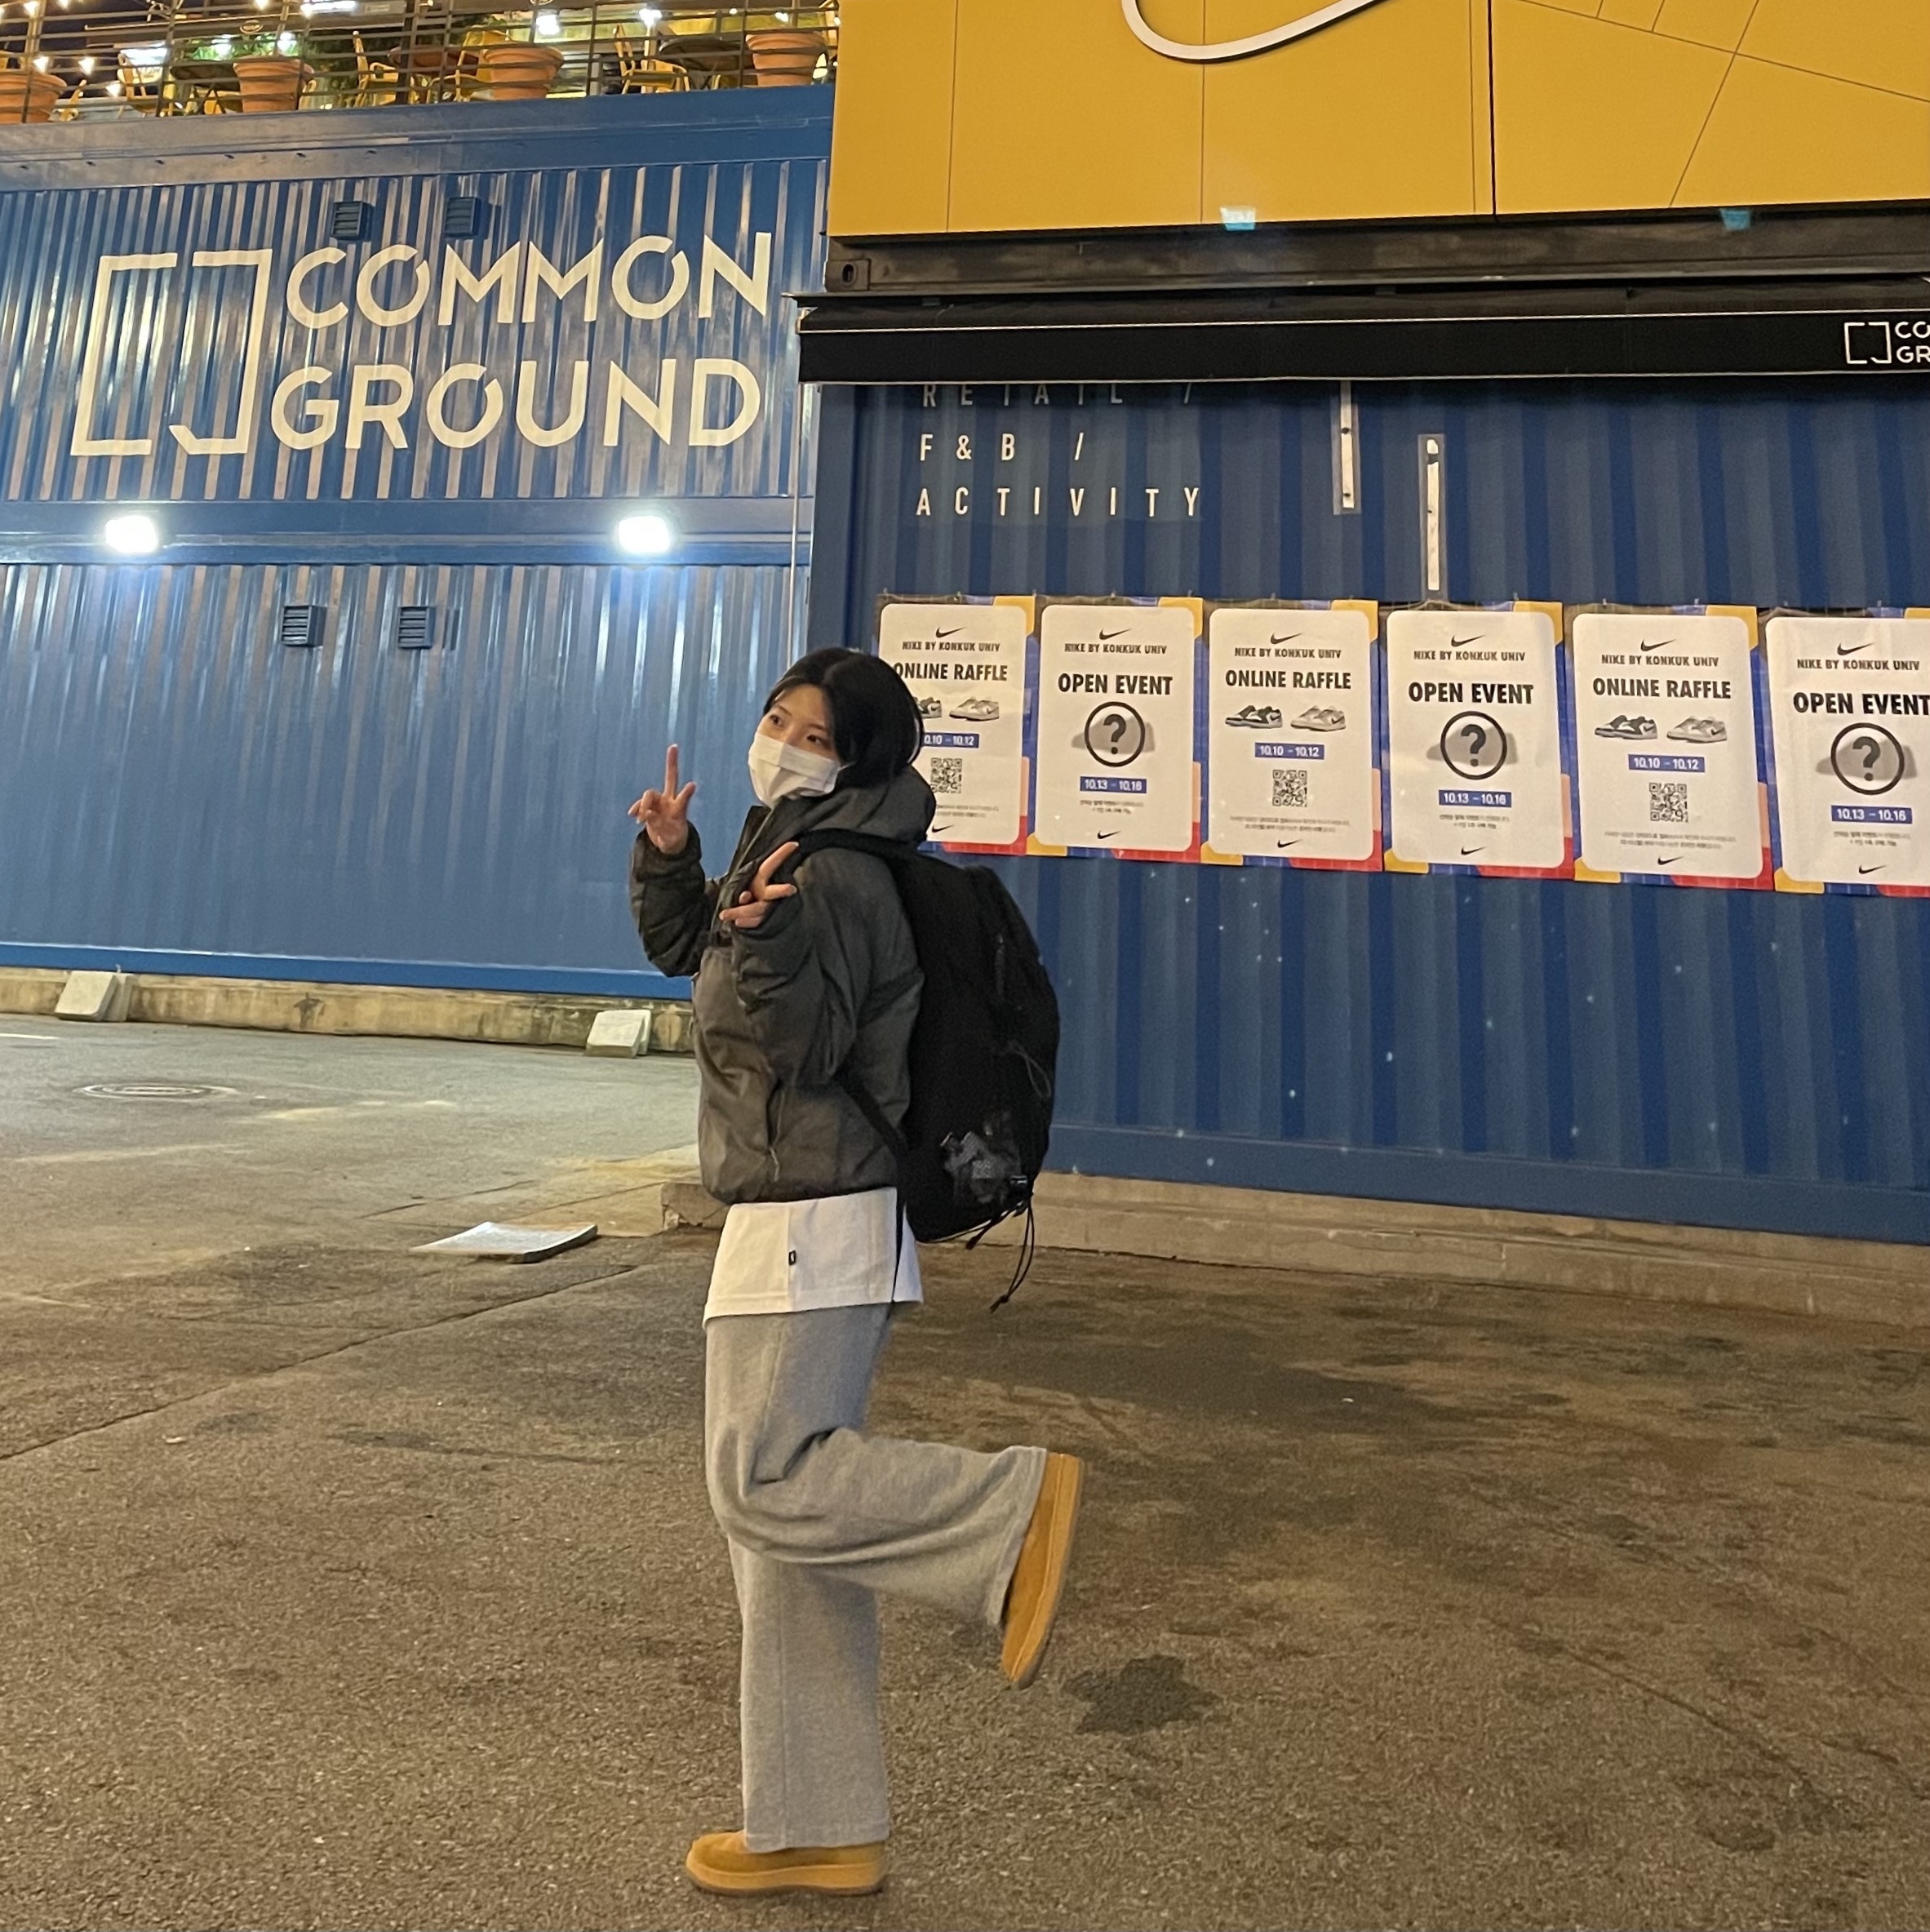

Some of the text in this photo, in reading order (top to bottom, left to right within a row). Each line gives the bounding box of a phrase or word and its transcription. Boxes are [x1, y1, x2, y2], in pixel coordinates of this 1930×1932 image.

[286, 232, 771, 329] COMMON
[270, 358, 762, 451] GROUND
[916, 486, 1200, 517] ACTIVITY
[902, 641, 1000, 652] NIKE BY KONKUK UNIV
[1064, 643, 1167, 655] NIKE BY KONKUK UNIV
[1235, 647, 1342, 659] NIKE BY KONKUK UNIV
[1413, 651, 1526, 662] NIKE BY KONKUK UNIV
[1601, 654, 1719, 667] NIKE BY KONKUK UNIV
[894, 662, 1008, 681] ONLINE RAFFLE
[1797, 659, 1920, 671] NIKE BY KONKUK UNIV
[1058, 673, 1174, 695] OPEN EVENT
[1225, 669, 1351, 690] ONLINE RAFFLE
[1408, 682, 1534, 704] OPEN EVENT
[1592, 677, 1731, 699] ONLINE RAFFLE
[1793, 691, 1930, 716] OPEN EVENT
[953, 735, 974, 746] 10.12
[1103, 713, 1127, 755] ?
[1259, 745, 1284, 756] 10.10
[1295, 746, 1320, 757] 10.12
[1461, 723, 1487, 767] ?
[1633, 757, 1660, 769] 10.10
[1673, 758, 1699, 770] 10.12
[1852, 735, 1881, 782] ?
[1085, 779, 1108, 790] 10.13
[1444, 793, 1469, 804] 10.13
[1837, 808, 1865, 820] 10.13
